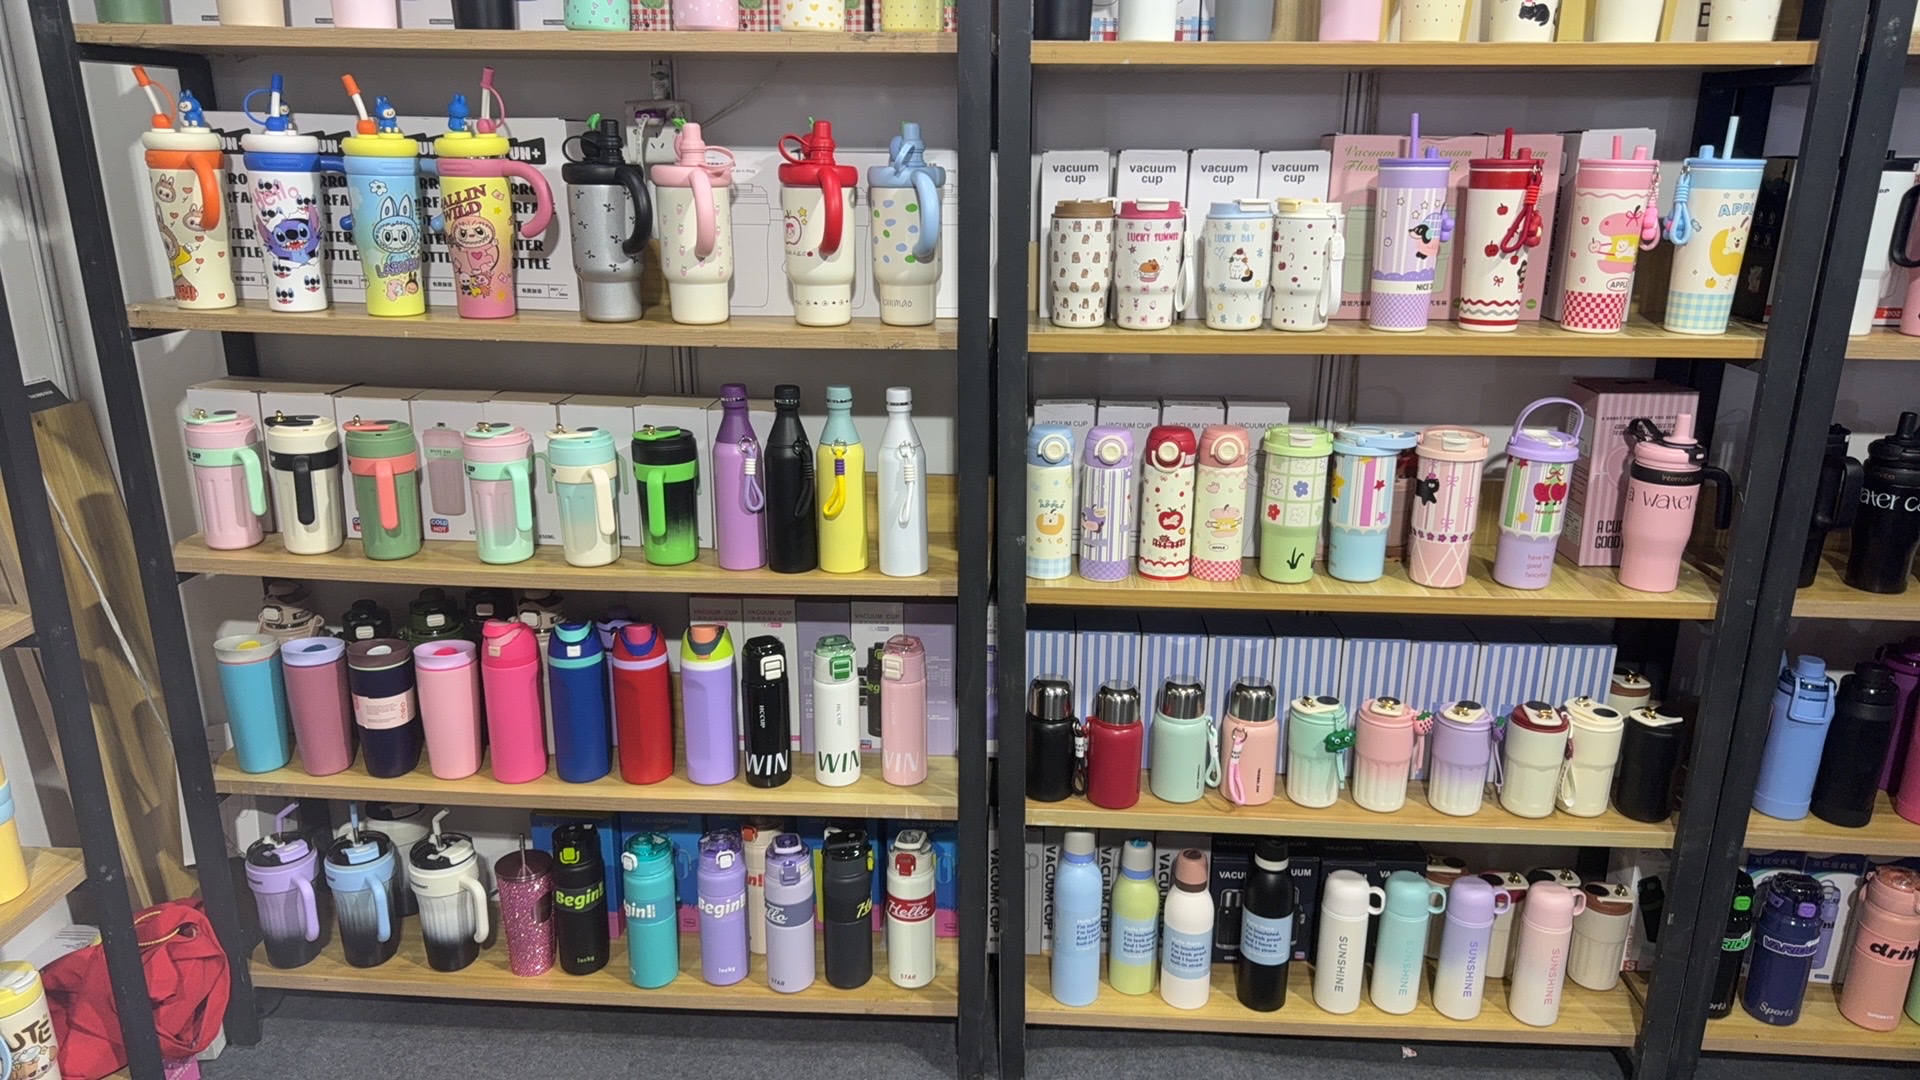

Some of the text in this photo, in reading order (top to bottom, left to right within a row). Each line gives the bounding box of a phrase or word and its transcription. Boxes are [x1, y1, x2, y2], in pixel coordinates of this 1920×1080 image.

[509, 146, 541, 160] UN+
[1344, 146, 1395, 157] Vacuum
[1052, 163, 1099, 173] vacuum
[1129, 163, 1177, 173] vacuum
[1201, 163, 1248, 173] vacuum
[1272, 163, 1319, 172] vacuum
[1065, 174, 1086, 184] cup
[1141, 174, 1163, 185] cup
[1212, 174, 1235, 185] cup
[1283, 174, 1305, 184] cup
[1127, 232, 1150, 242] LUCKY
[1214, 233, 1255, 243] LUCKY DAY
[512, 258, 551, 270] OTTLE
[1595, 535, 1620, 548] GOOD
[745, 749, 789, 776] WIN
[884, 749, 919, 773] WIN
[1219, 871, 1246, 879] VACU
[1291, 868, 1312, 876] UUM
[990, 848, 999, 933] VACUUM CUP
[1044, 846, 1056, 930] VACUUM CUP
[889, 900, 930, 918] Hello
[1100, 906, 1110, 932] CUP
[1870, 942, 1917, 960] drin
[1334, 935, 1348, 993] SUNSHINE
[1398, 940, 1415, 996] SUNSHINE
[1463, 941, 1478, 998] SUNSHINE
[1544, 948, 1560, 1005] SUNSHINE
[1759, 1001, 1793, 1017] Sports
[10, 1019, 52, 1052] UTE
